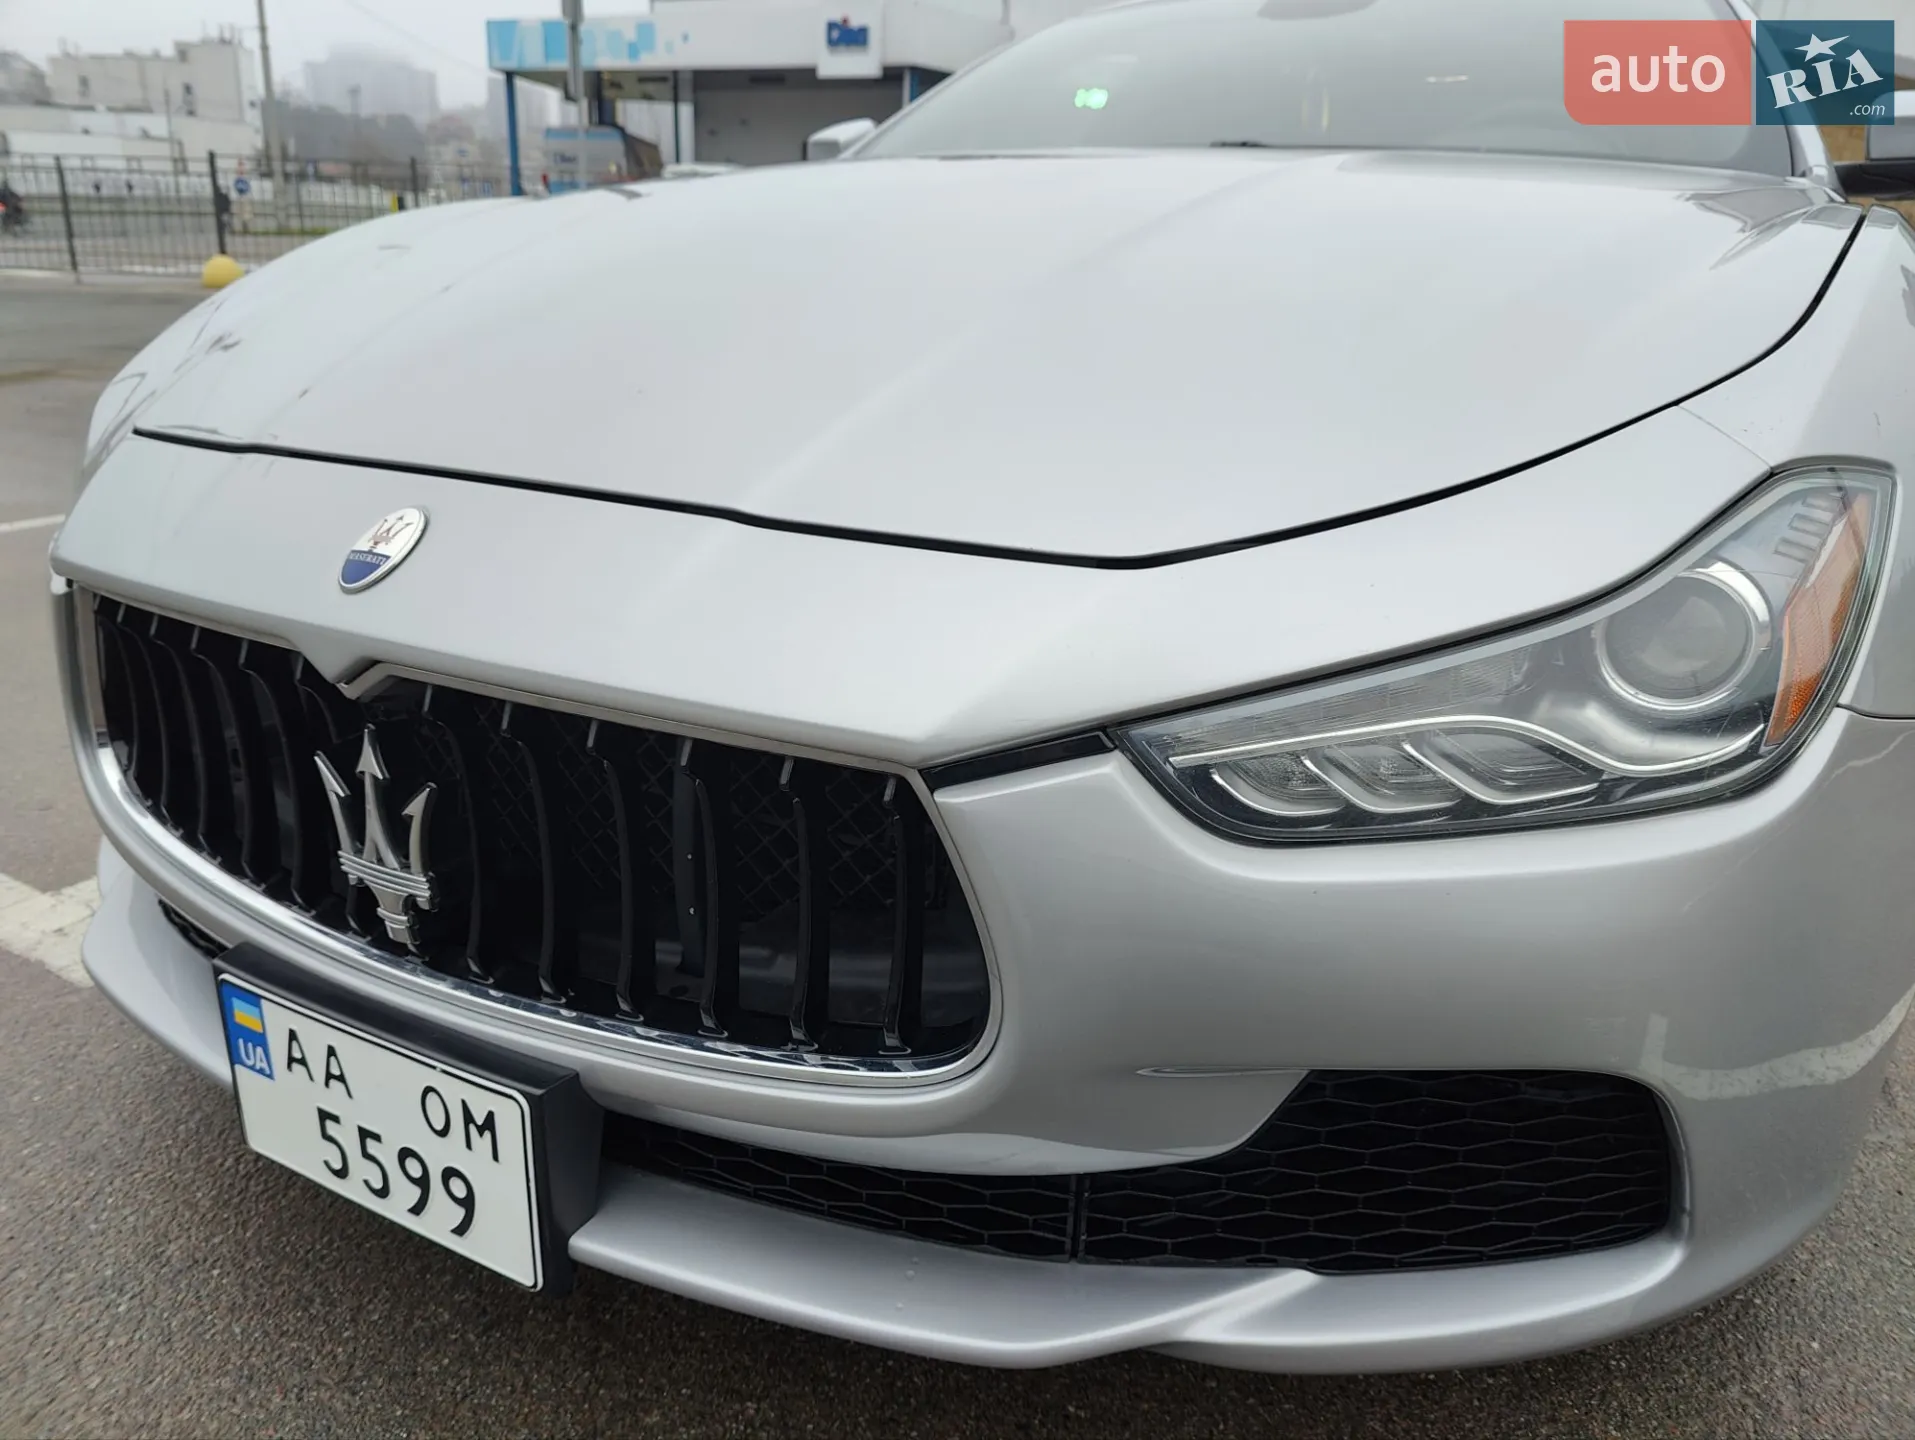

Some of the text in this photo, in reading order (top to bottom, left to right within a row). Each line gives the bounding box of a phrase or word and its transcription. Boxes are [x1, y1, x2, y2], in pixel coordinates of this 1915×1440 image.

[349, 552, 388, 566] MASERATI
[237, 1038, 269, 1075] UA
[286, 1028, 500, 1163] AA OM
[316, 1106, 476, 1237] 5599
